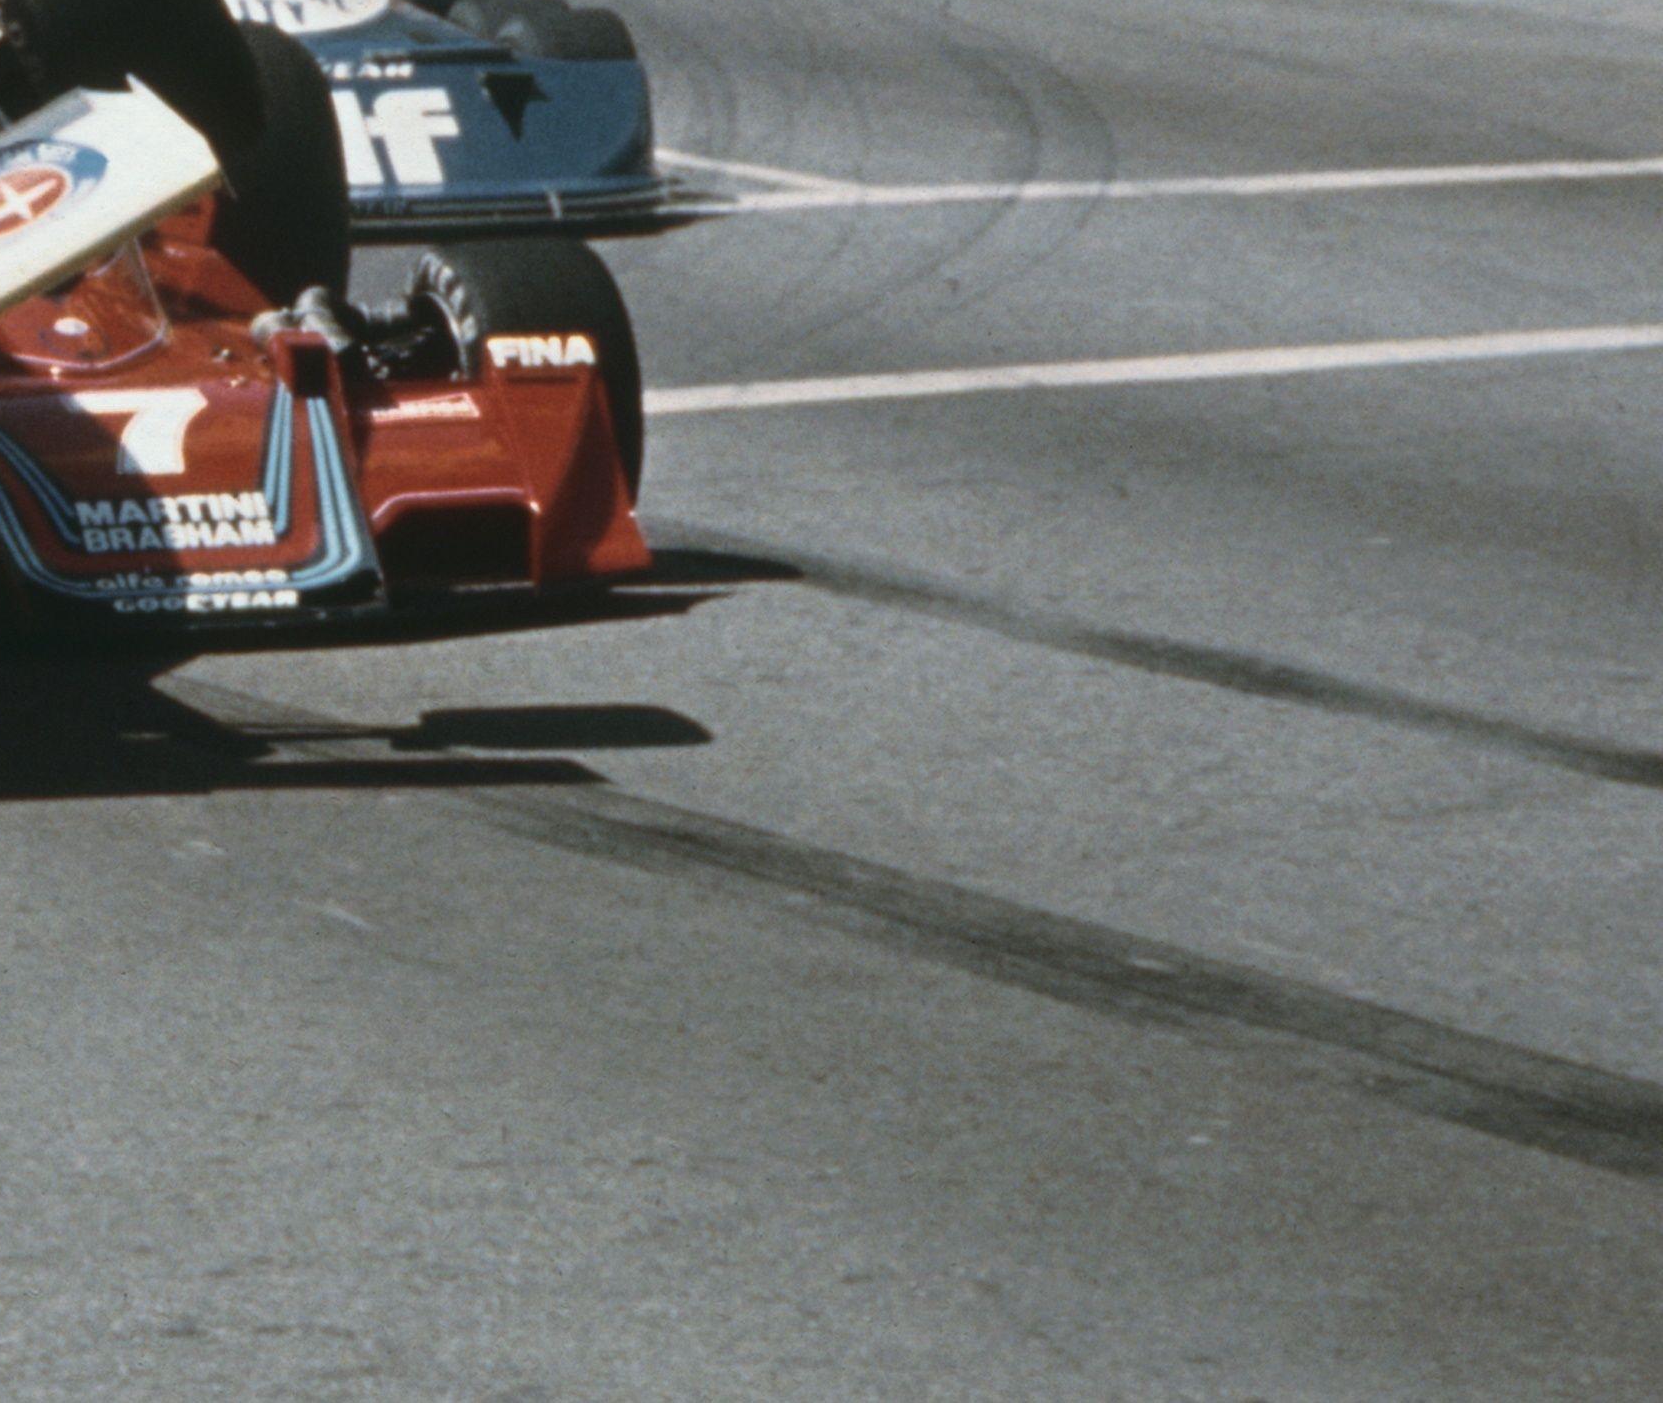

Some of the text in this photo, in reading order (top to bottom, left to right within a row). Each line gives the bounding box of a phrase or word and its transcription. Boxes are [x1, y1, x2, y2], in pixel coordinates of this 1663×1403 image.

[240, 0, 308, 26] ITY
[331, 87, 461, 187] lf
[486, 333, 598, 369] FINA
[74, 388, 209, 475] 7
[75, 491, 269, 526] MARTINI
[81, 518, 277, 553] BRABHAM
